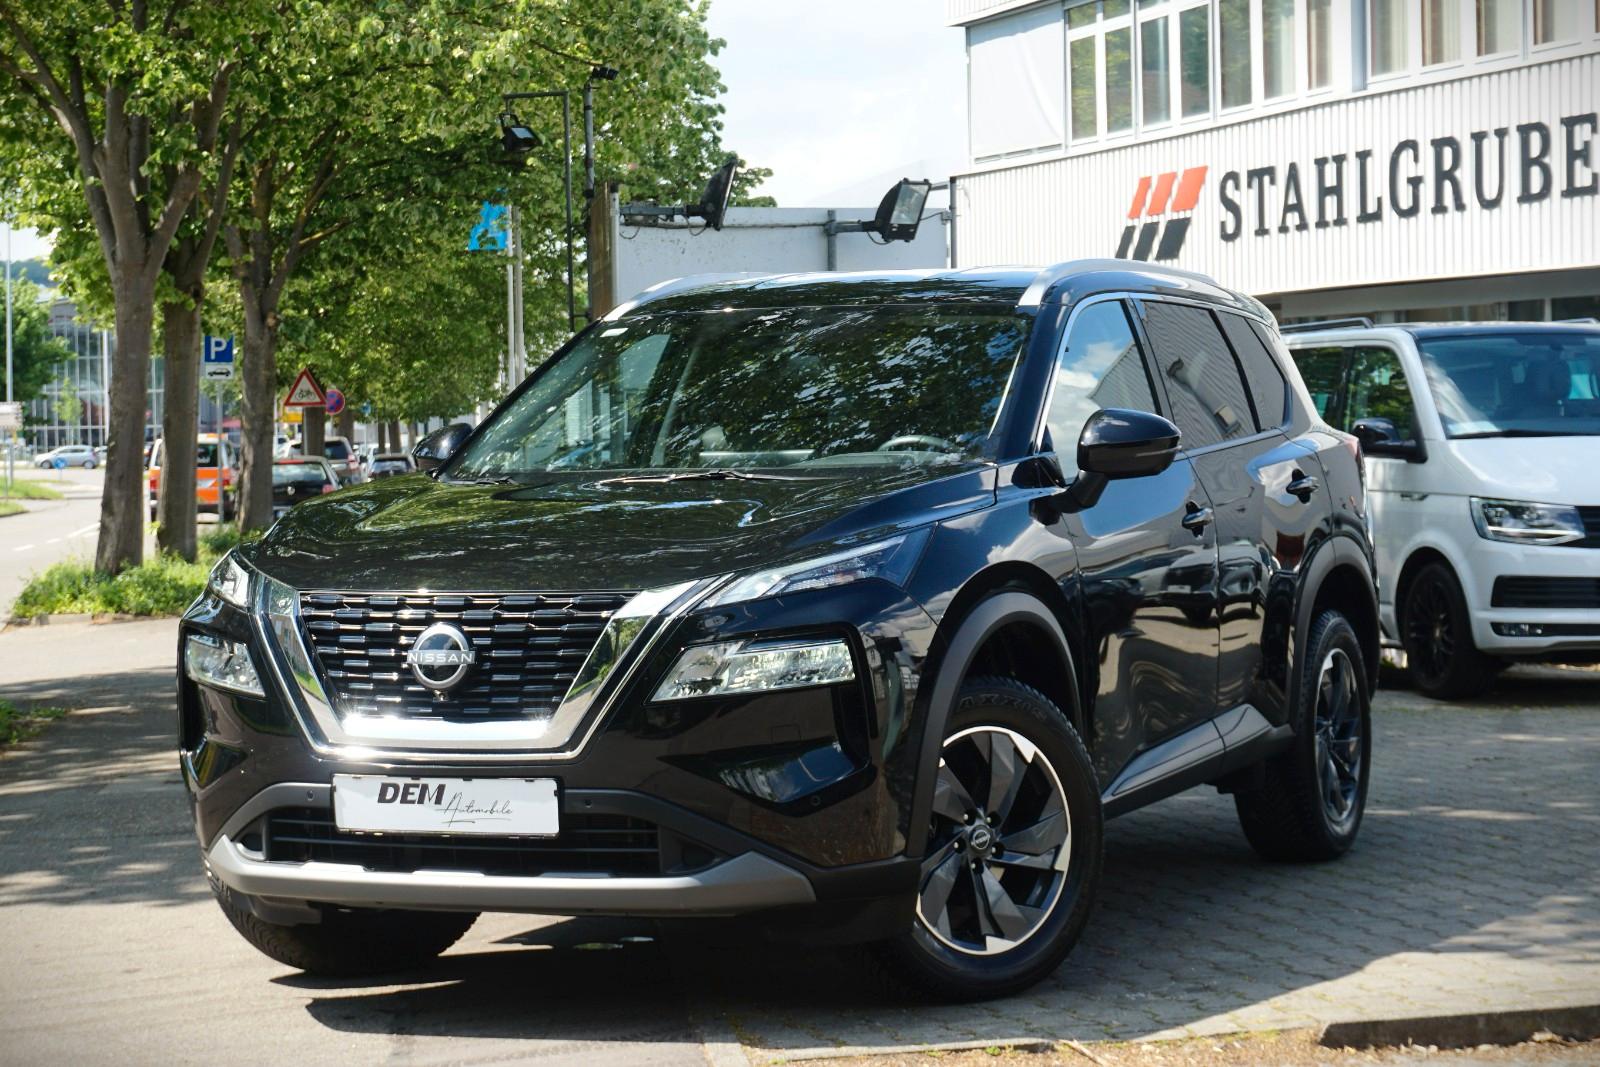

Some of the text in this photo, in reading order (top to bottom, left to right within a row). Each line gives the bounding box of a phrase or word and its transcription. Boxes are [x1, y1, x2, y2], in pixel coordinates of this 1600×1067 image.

[1220, 112, 1599, 242] STAHLGRUBE
[211, 336, 227, 360] P
[409, 652, 472, 663] NISSAN
[377, 782, 446, 805] DEM
[435, 792, 512, 826] Automobile
